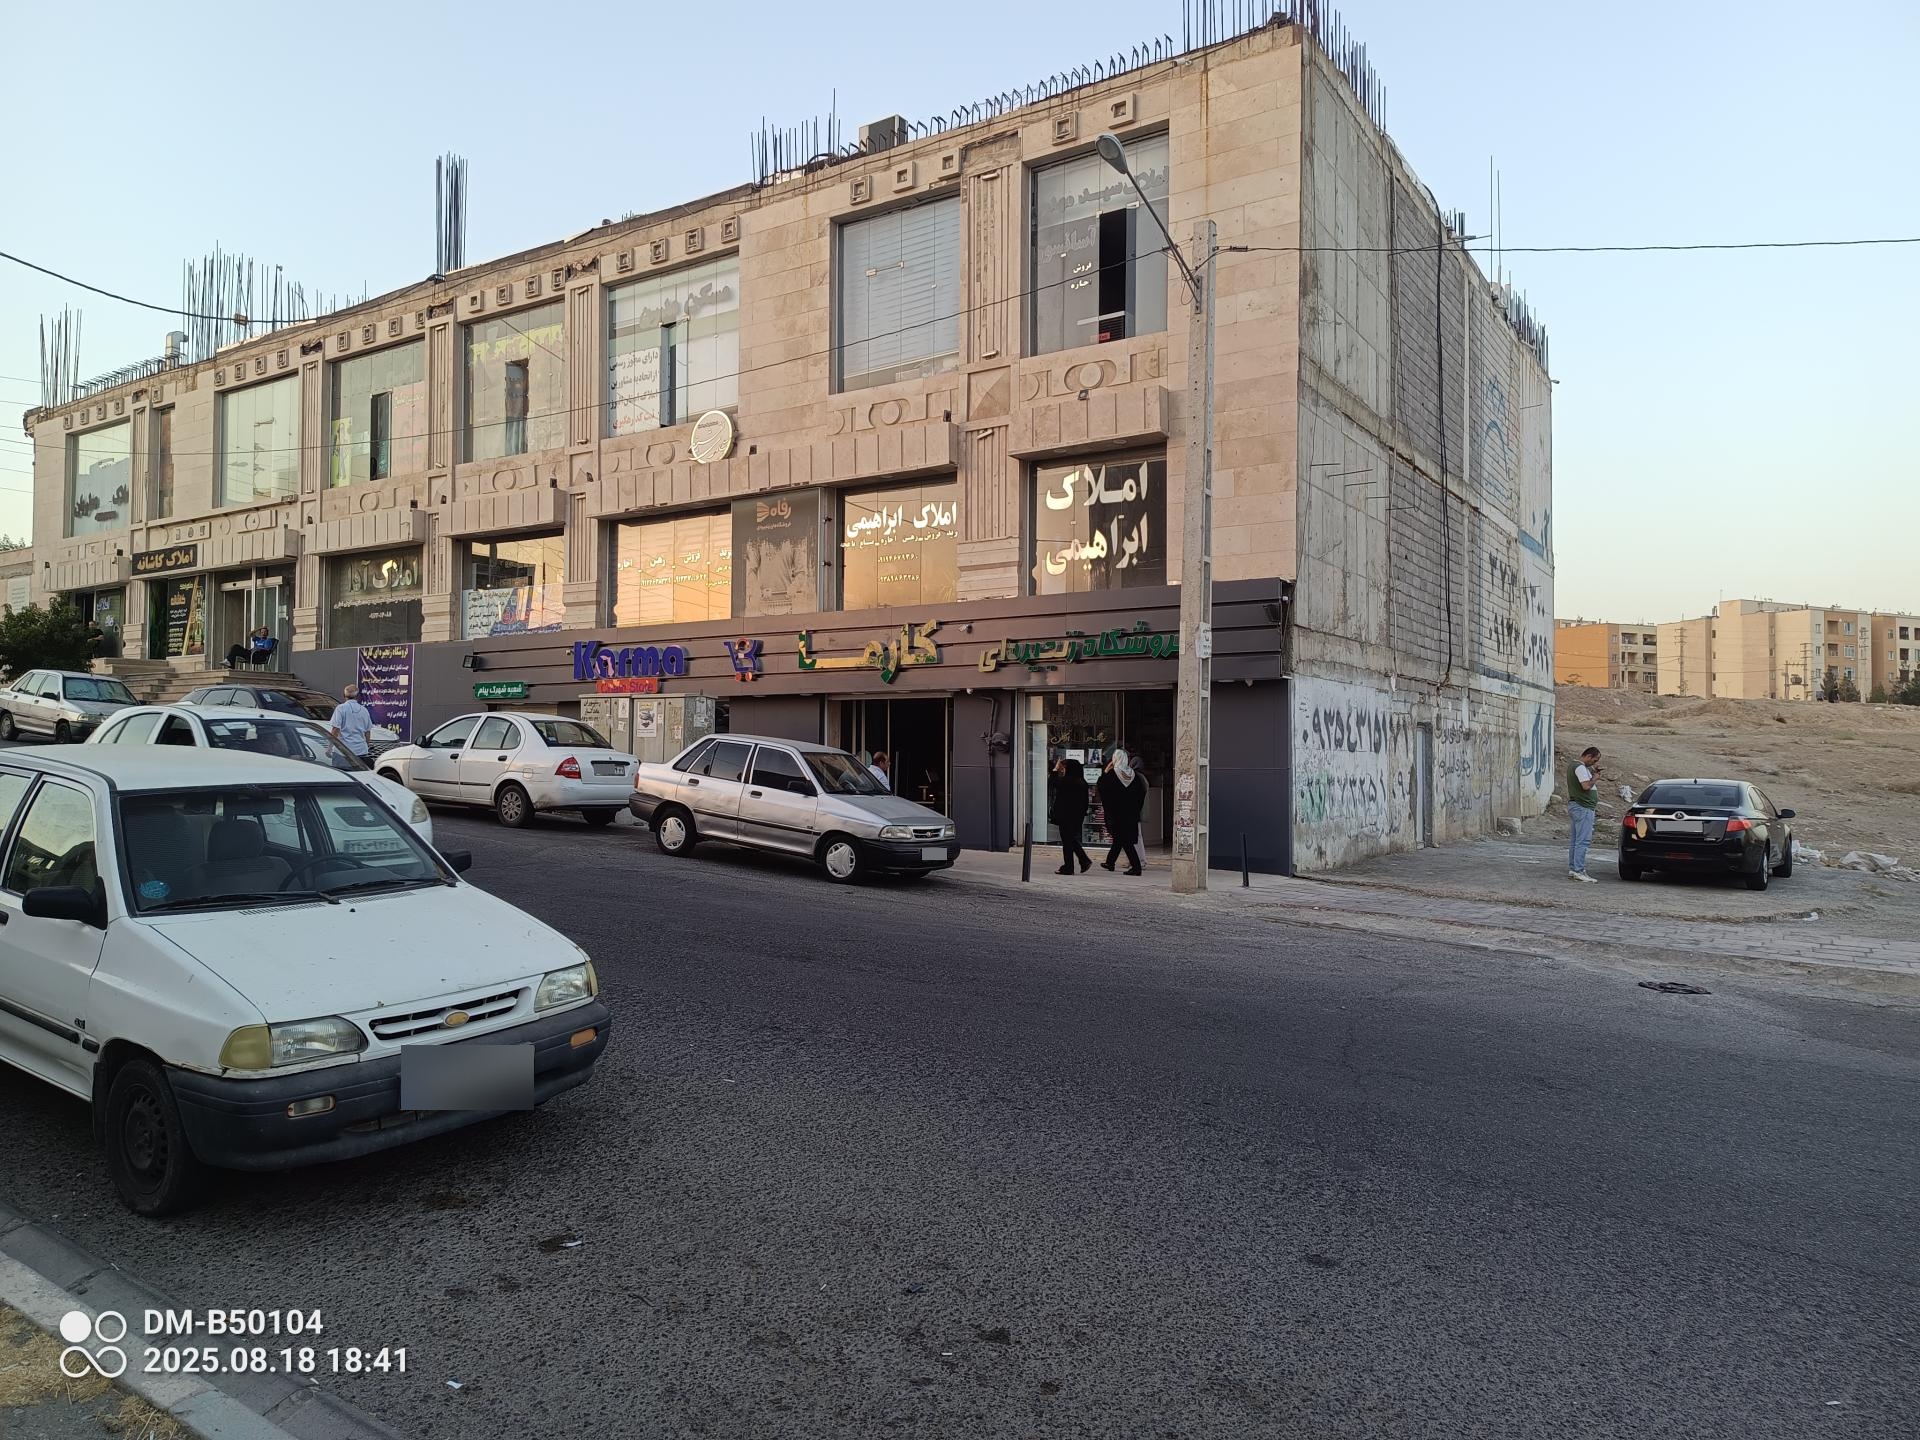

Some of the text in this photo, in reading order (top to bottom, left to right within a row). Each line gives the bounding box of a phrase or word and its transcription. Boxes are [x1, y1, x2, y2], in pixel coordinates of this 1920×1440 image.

[1045, 460, 1148, 511] املاک
[770, 497, 792, 520] رفاه
[846, 501, 957, 539] املاک ابراهیمی
[137, 549, 193, 571] املاک کاشانه
[1045, 511, 1148, 576] ابراهیمی
[798, 618, 940, 685] کارما
[1082, 620, 1181, 659] روشگاه
[573, 640, 686, 681] Karma
[477, 683, 522, 698] شعبه شهرک پیام
[630, 680, 654, 694] Store
